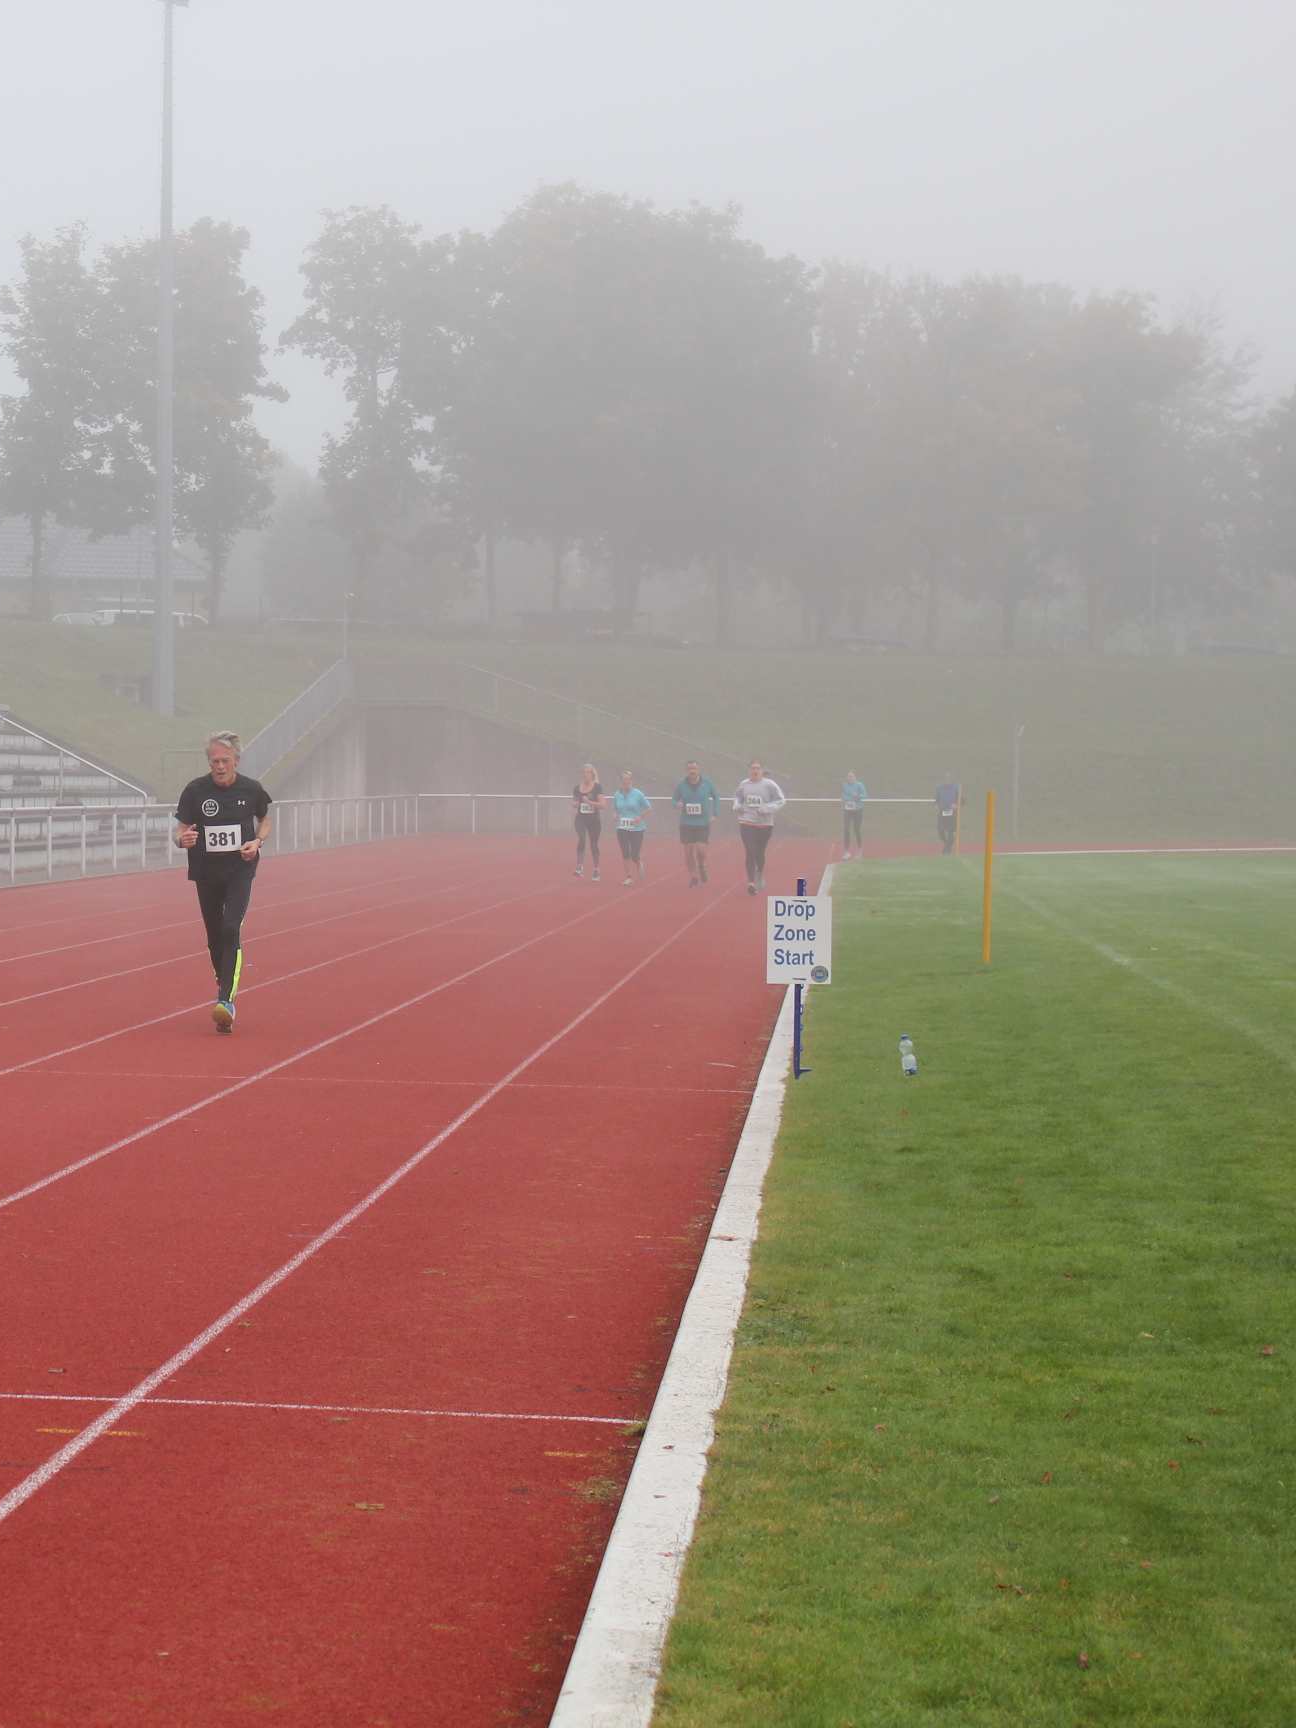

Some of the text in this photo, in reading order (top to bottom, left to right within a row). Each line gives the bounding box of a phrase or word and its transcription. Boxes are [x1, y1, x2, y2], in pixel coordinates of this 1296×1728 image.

[208, 831, 236, 847] 381
[775, 900, 815, 920] Drop
[774, 924, 816, 940] Zone
[774, 948, 814, 965] Start
